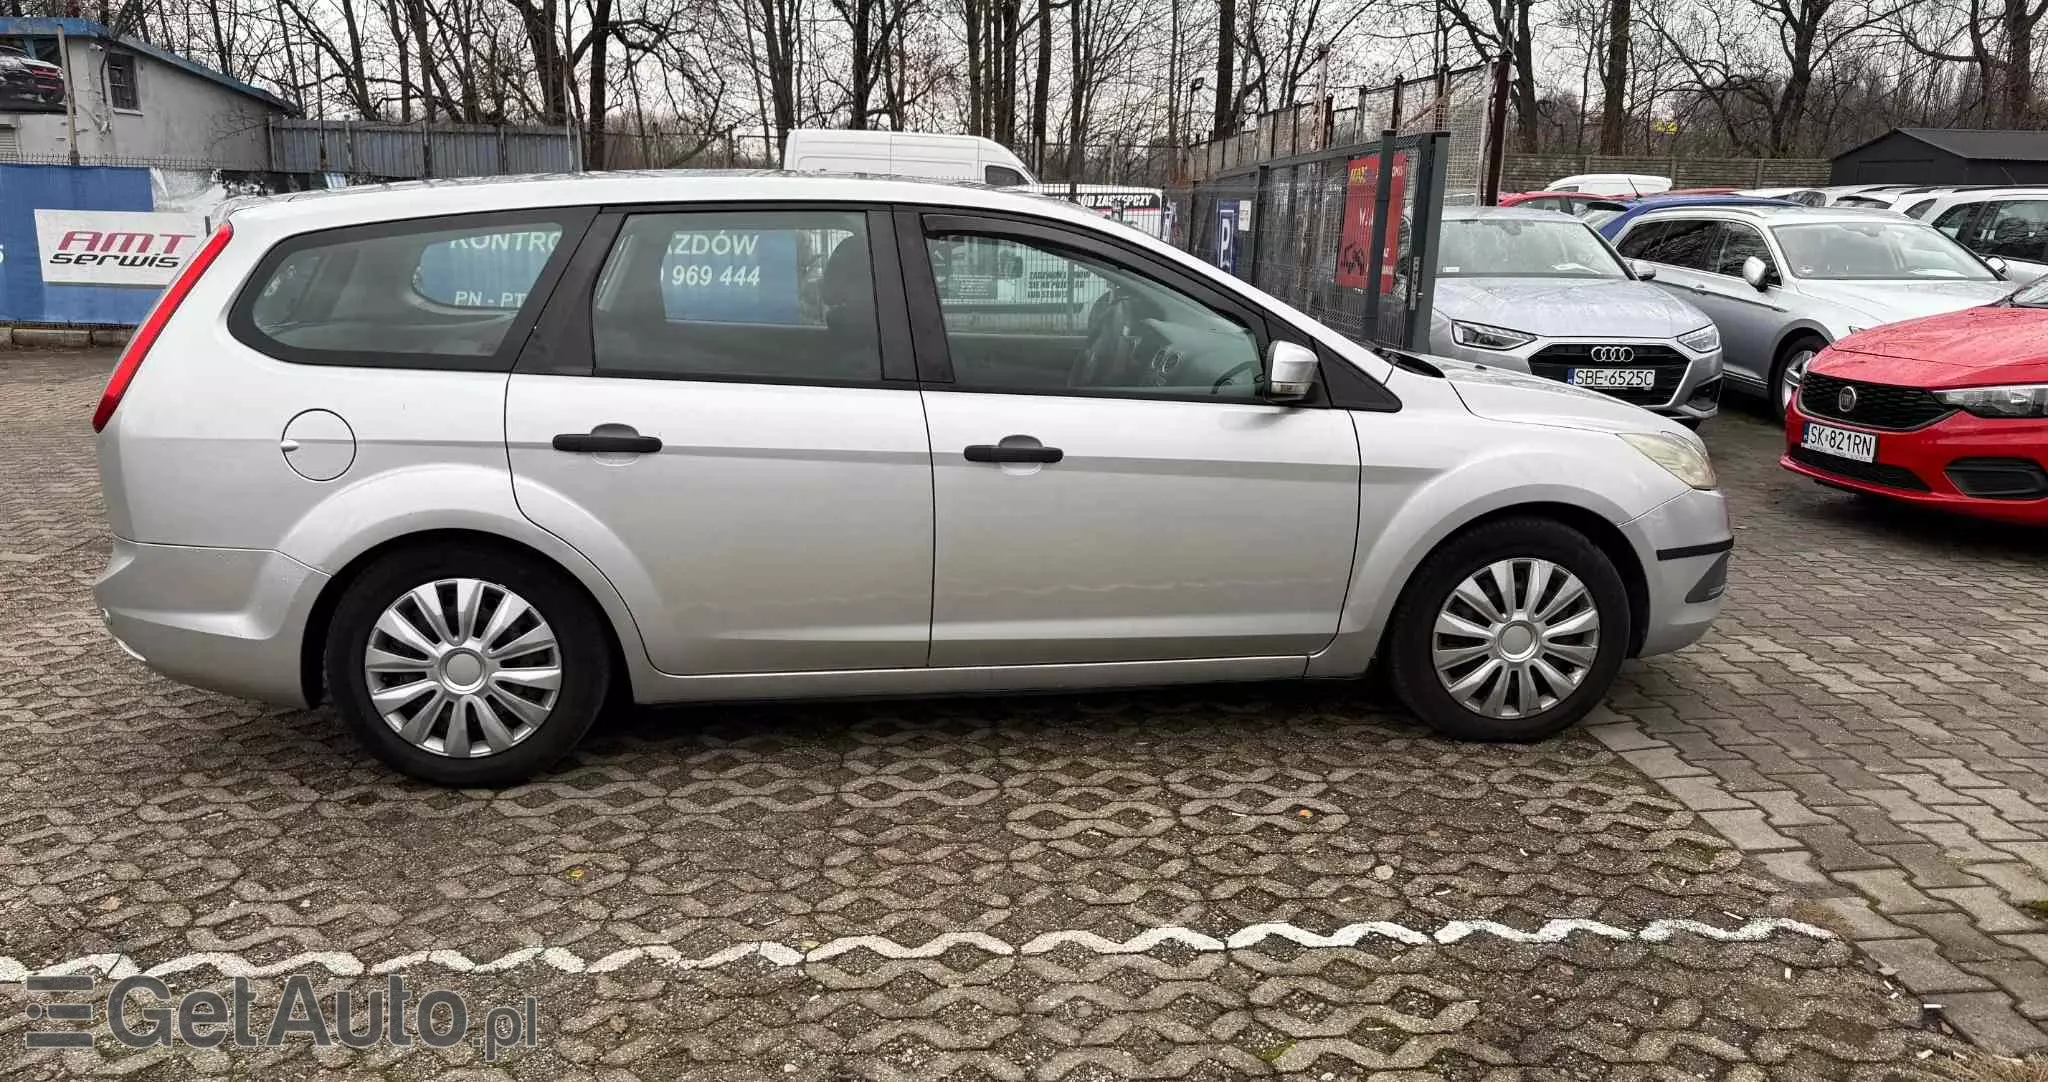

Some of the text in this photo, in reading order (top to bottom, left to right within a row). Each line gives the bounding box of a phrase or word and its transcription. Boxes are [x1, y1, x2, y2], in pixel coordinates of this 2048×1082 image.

[58, 230, 196, 254] AMT
[668, 230, 760, 255] ZDÓW
[49, 253, 179, 268] serwis
[671, 265, 713, 286] 969
[719, 265, 761, 287] 444
[455, 291, 483, 307] PN
[1575, 369, 1653, 386] SBE 6525C
[1810, 425, 1873, 456] SK 821RN
